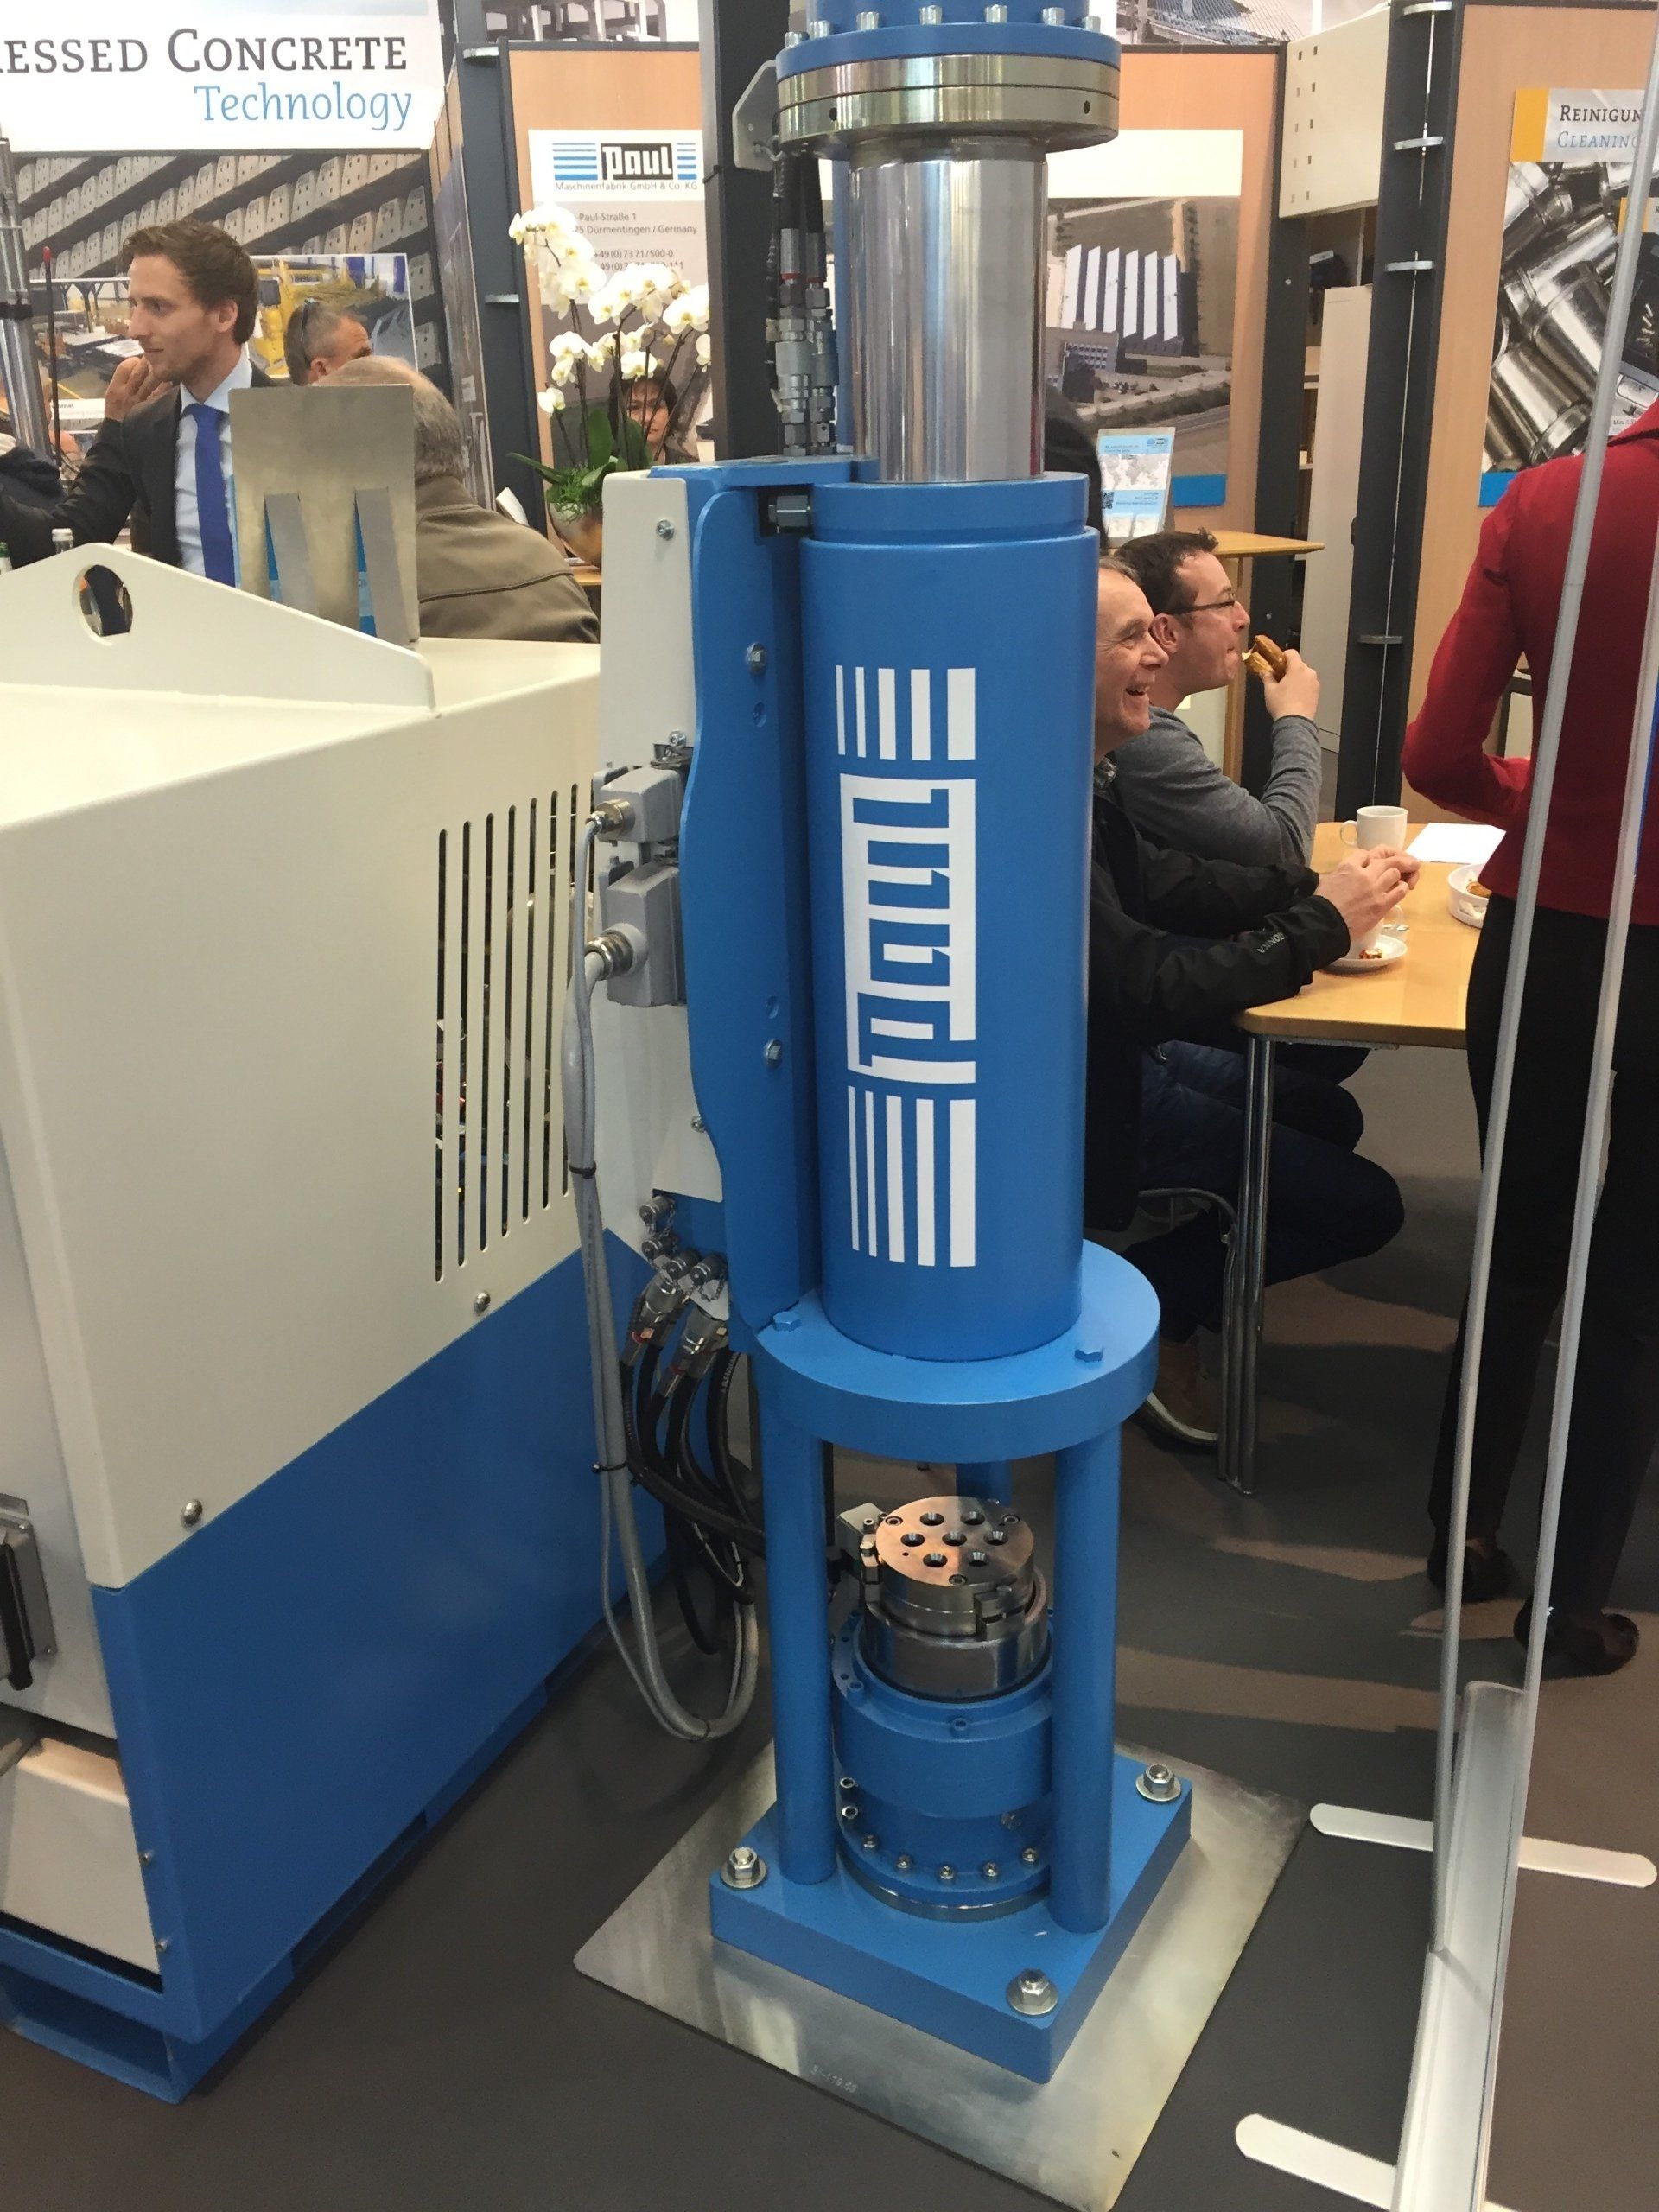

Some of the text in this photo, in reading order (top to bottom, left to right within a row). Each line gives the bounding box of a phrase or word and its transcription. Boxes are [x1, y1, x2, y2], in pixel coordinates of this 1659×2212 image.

[0, 28, 407, 73] ESSED CONCRETE
[194, 80, 412, 131] Technology
[555, 181, 627, 191] Maschinenfabrik
[630, 181, 658, 191] GmbH
[659, 181, 666, 190] &
[684, 181, 698, 191] KG
[632, 212, 636, 221] 1
[658, 224, 697, 236] Germany
